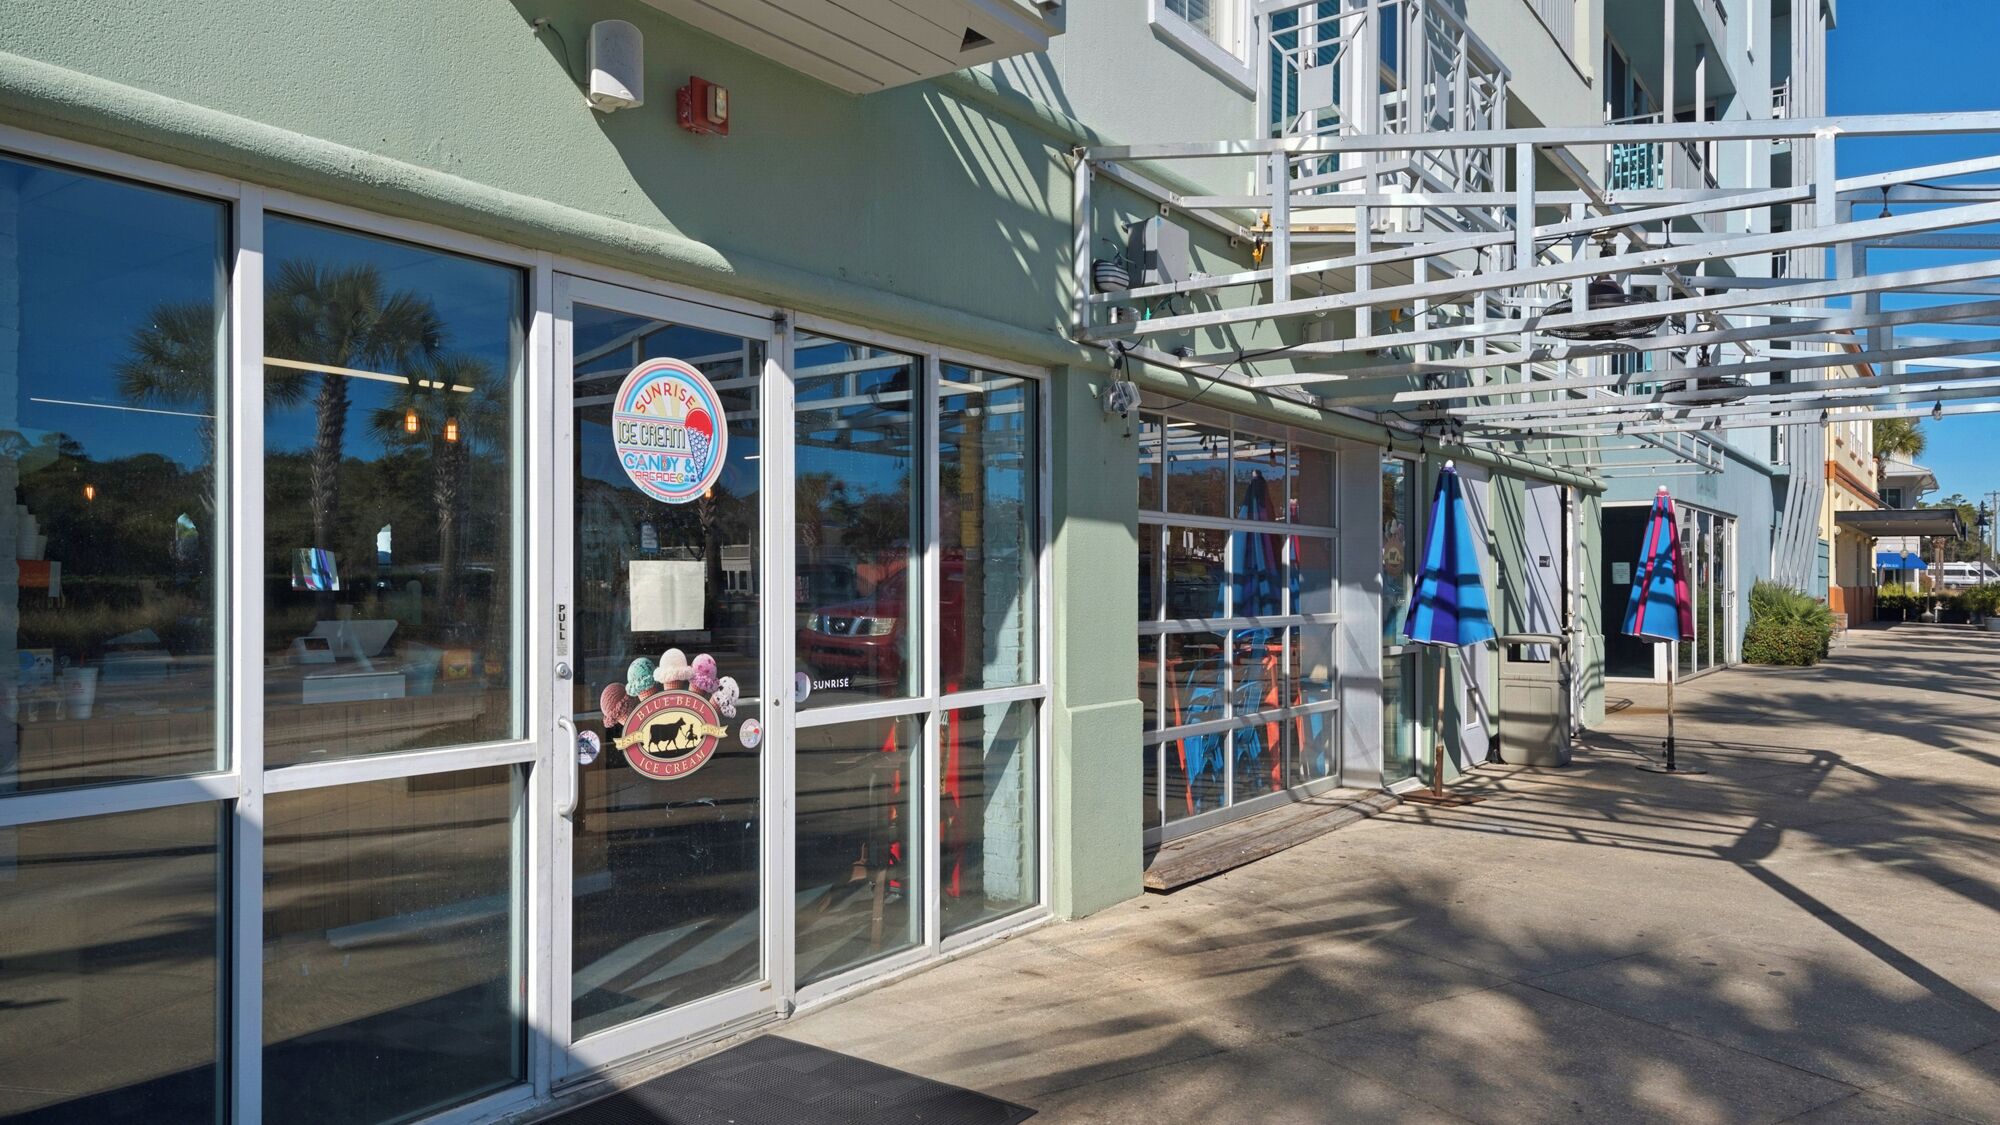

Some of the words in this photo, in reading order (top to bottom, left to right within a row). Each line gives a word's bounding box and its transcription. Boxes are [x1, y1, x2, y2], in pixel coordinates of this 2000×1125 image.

[635, 382, 696, 414] SUNRISE
[617, 420, 638, 445] ICE
[640, 423, 686, 449] CREAM
[623, 453, 679, 472] CANDY
[684, 458, 695, 474] &
[634, 470, 676, 482] ARCADE
[558, 604, 566, 640] PULL
[813, 678, 849, 690] SUNRISE
[636, 697, 671, 721] BLUE
[675, 696, 705, 714] BELL
[639, 758, 659, 774] ICE
[665, 750, 706, 774] CREAM
